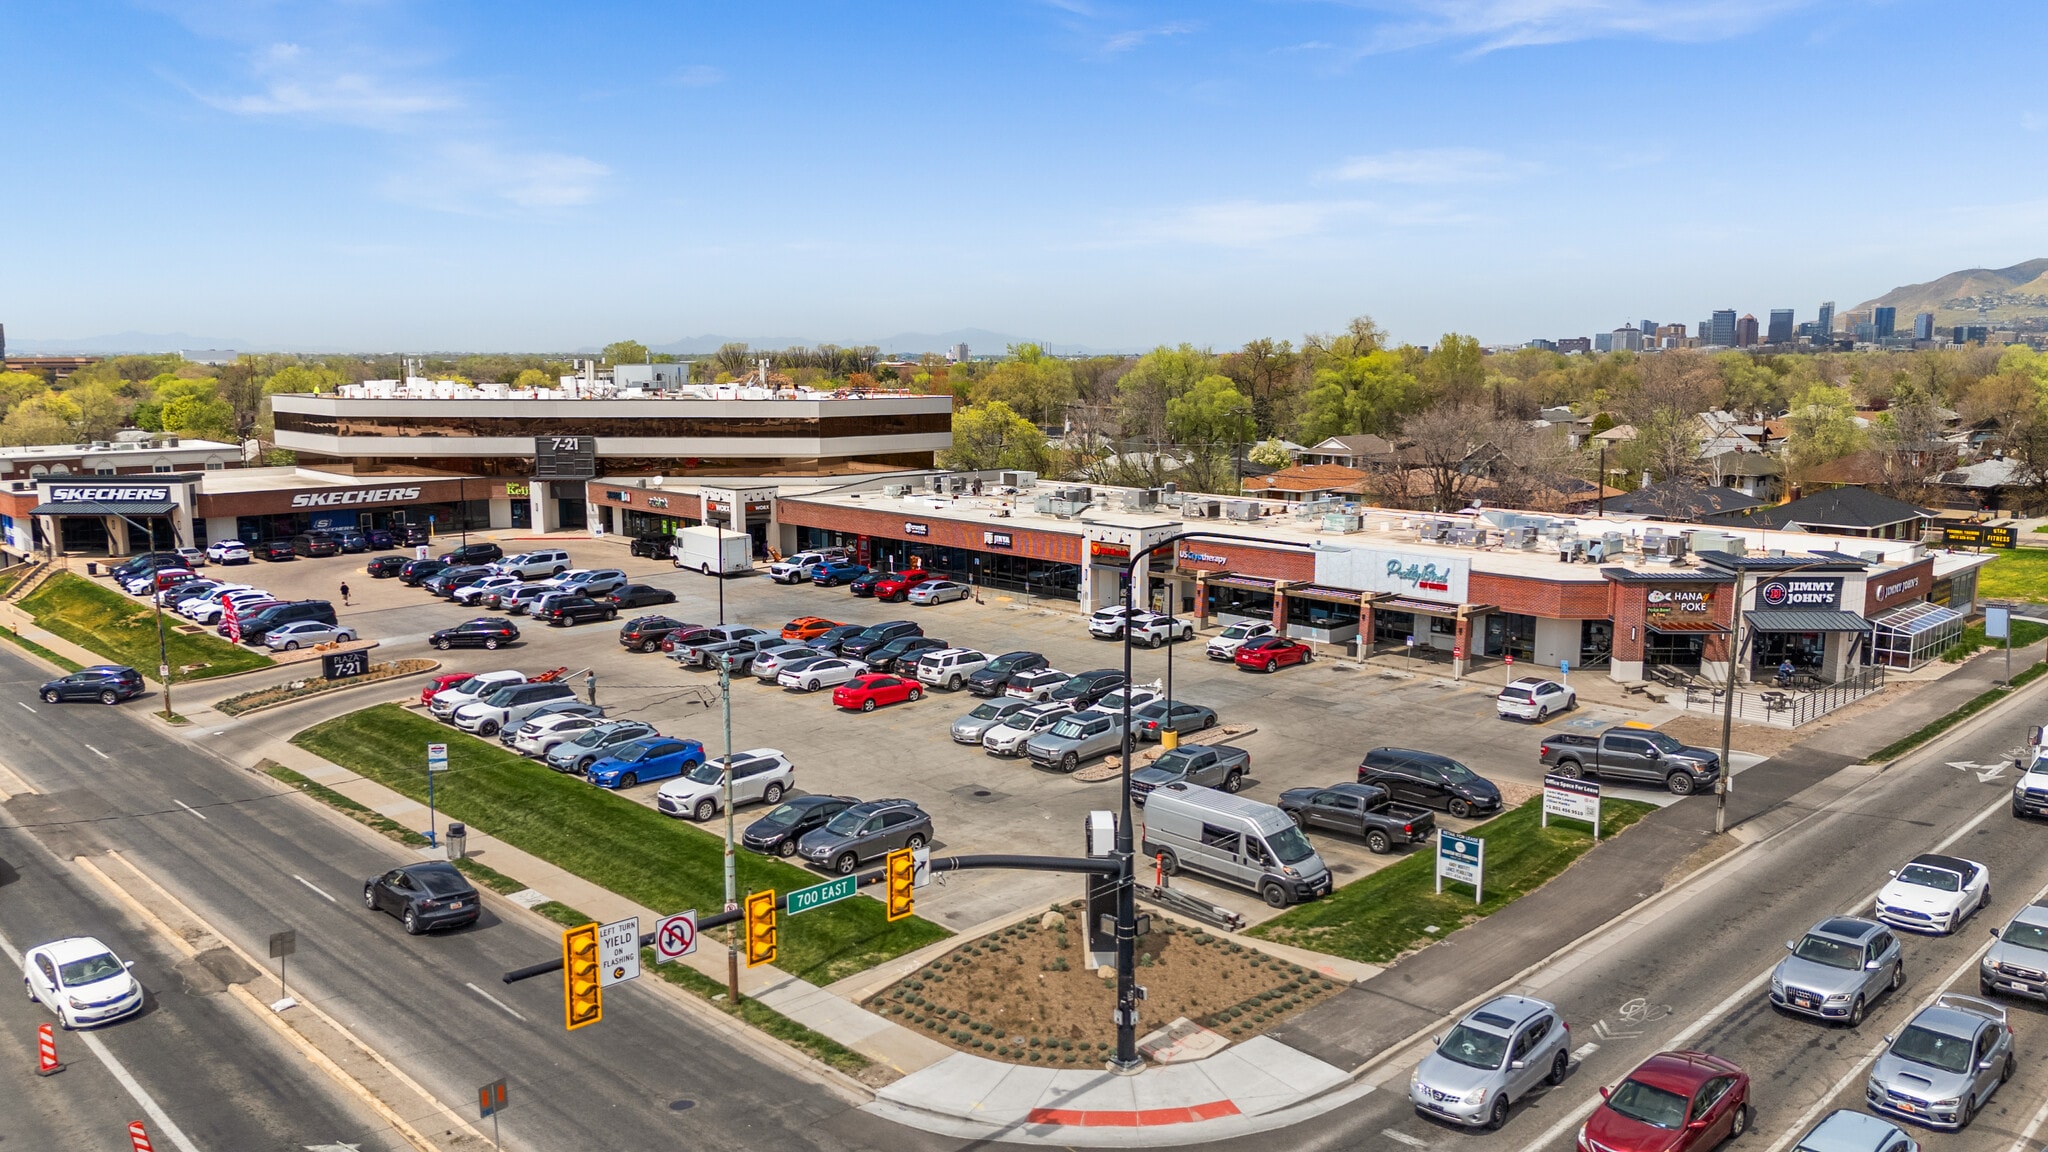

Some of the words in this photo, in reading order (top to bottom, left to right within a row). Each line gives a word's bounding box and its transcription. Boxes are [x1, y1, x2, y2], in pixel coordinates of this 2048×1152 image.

[552, 438, 578, 450] 7-21
[52, 488, 167, 500] SKECHERS
[291, 487, 421, 507] SKECHERS
[507, 487, 529, 495] Keij
[708, 503, 730, 511] WORX
[1987, 534, 2010, 543] FITNESS
[1788, 582, 1834, 592] JIMMY
[1884, 582, 1904, 599] JIMMY
[1674, 592, 1703, 601] HANA
[1787, 593, 1835, 604] JOHN'S
[1681, 602, 1706, 611] POKE
[334, 654, 359, 663] PLAZA
[335, 662, 361, 676] 7-21
[1545, 778, 1560, 786] Office
[1560, 781, 1575, 790] Space
[1584, 786, 1598, 794] Lease
[797, 891, 818, 908] 700
[822, 881, 848, 900] EAST
[600, 927, 615, 938] LEFT
[619, 921, 636, 932] TURN
[605, 932, 632, 948] YIELD
[614, 948, 628, 956] ON
[603, 952, 635, 968] FLASHING
